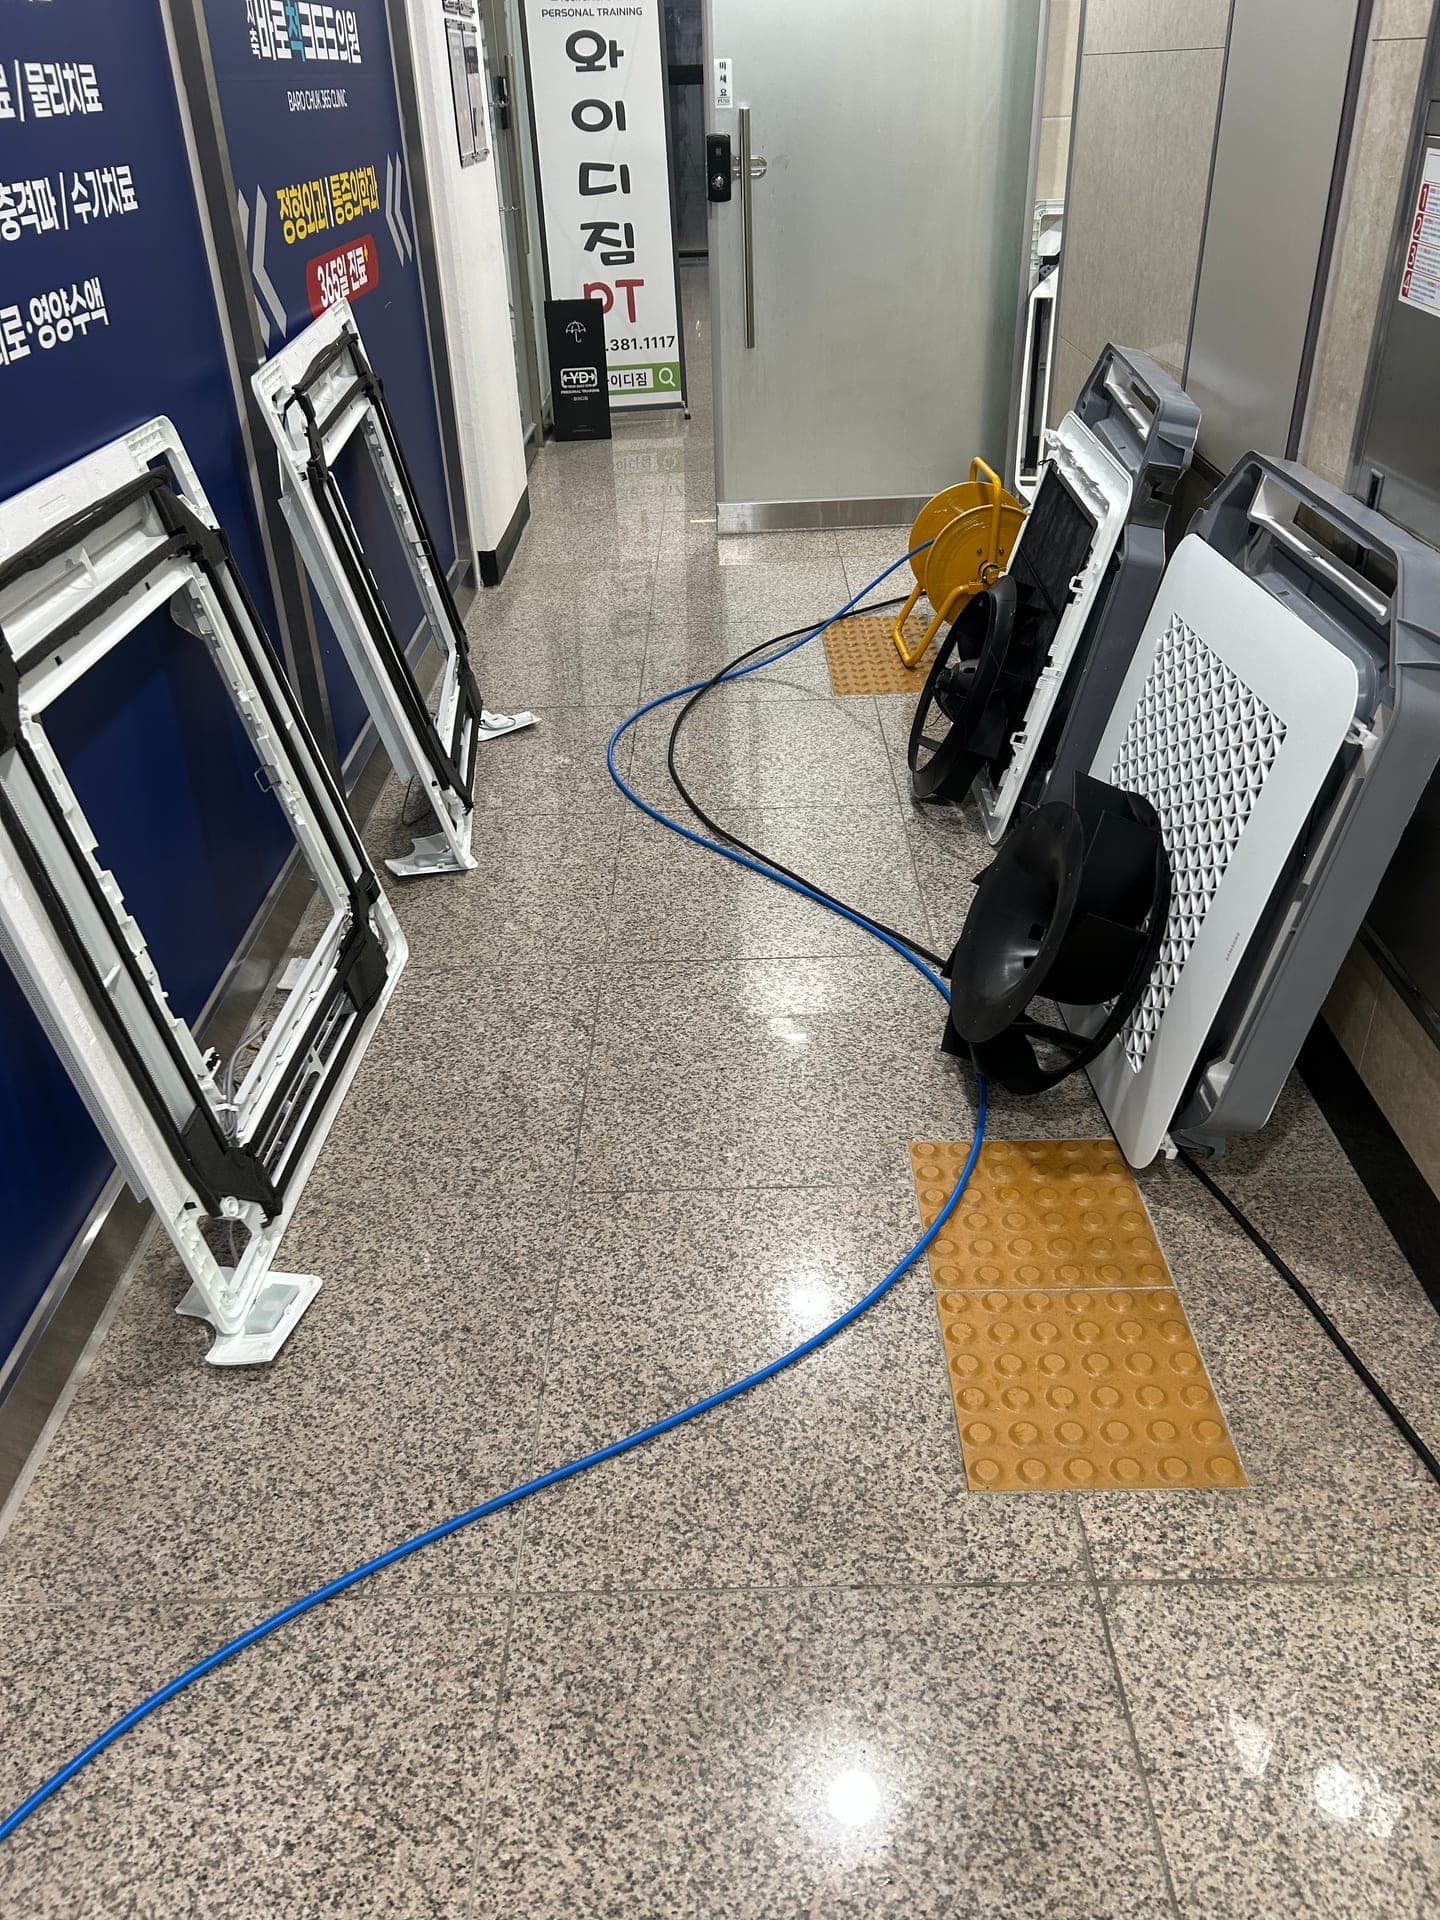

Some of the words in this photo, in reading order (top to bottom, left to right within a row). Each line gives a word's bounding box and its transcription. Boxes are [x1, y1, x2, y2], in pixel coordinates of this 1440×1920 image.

[541, 8, 595, 18] PERSONAL
[597, 7, 643, 17] TRAINING
[24, 62, 104, 118] 물리치료
[287, 90, 306, 112] BARO
[71, 165, 139, 224] 수기치료
[276, 178, 329, 245] 정형외과
[329, 165, 380, 225] 통증의학과
[317, 254, 350, 308] 365일
[607, 372, 648, 388] 이디짐
